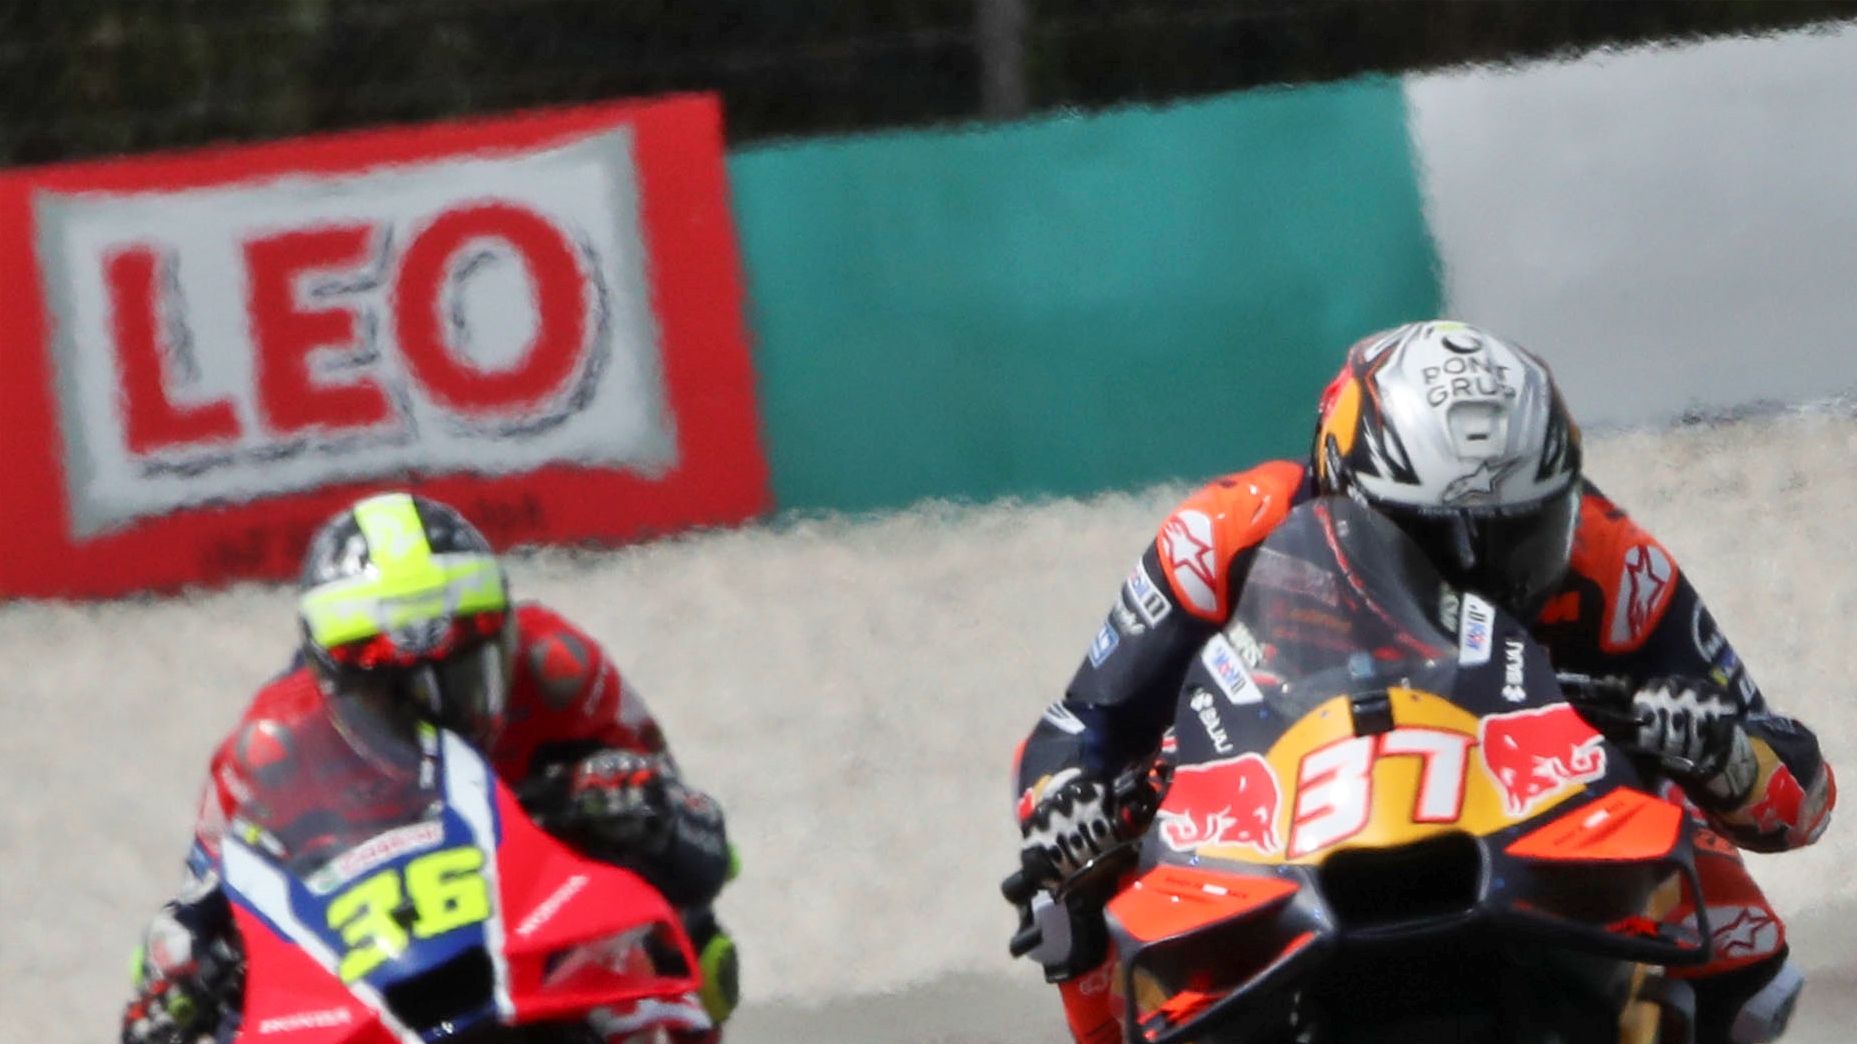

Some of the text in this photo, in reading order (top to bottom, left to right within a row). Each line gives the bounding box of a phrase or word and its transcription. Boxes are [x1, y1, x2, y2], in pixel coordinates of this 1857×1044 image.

[105, 203, 588, 454] LEO
[1288, 726, 1479, 858] 37
[327, 846, 490, 984] 36
